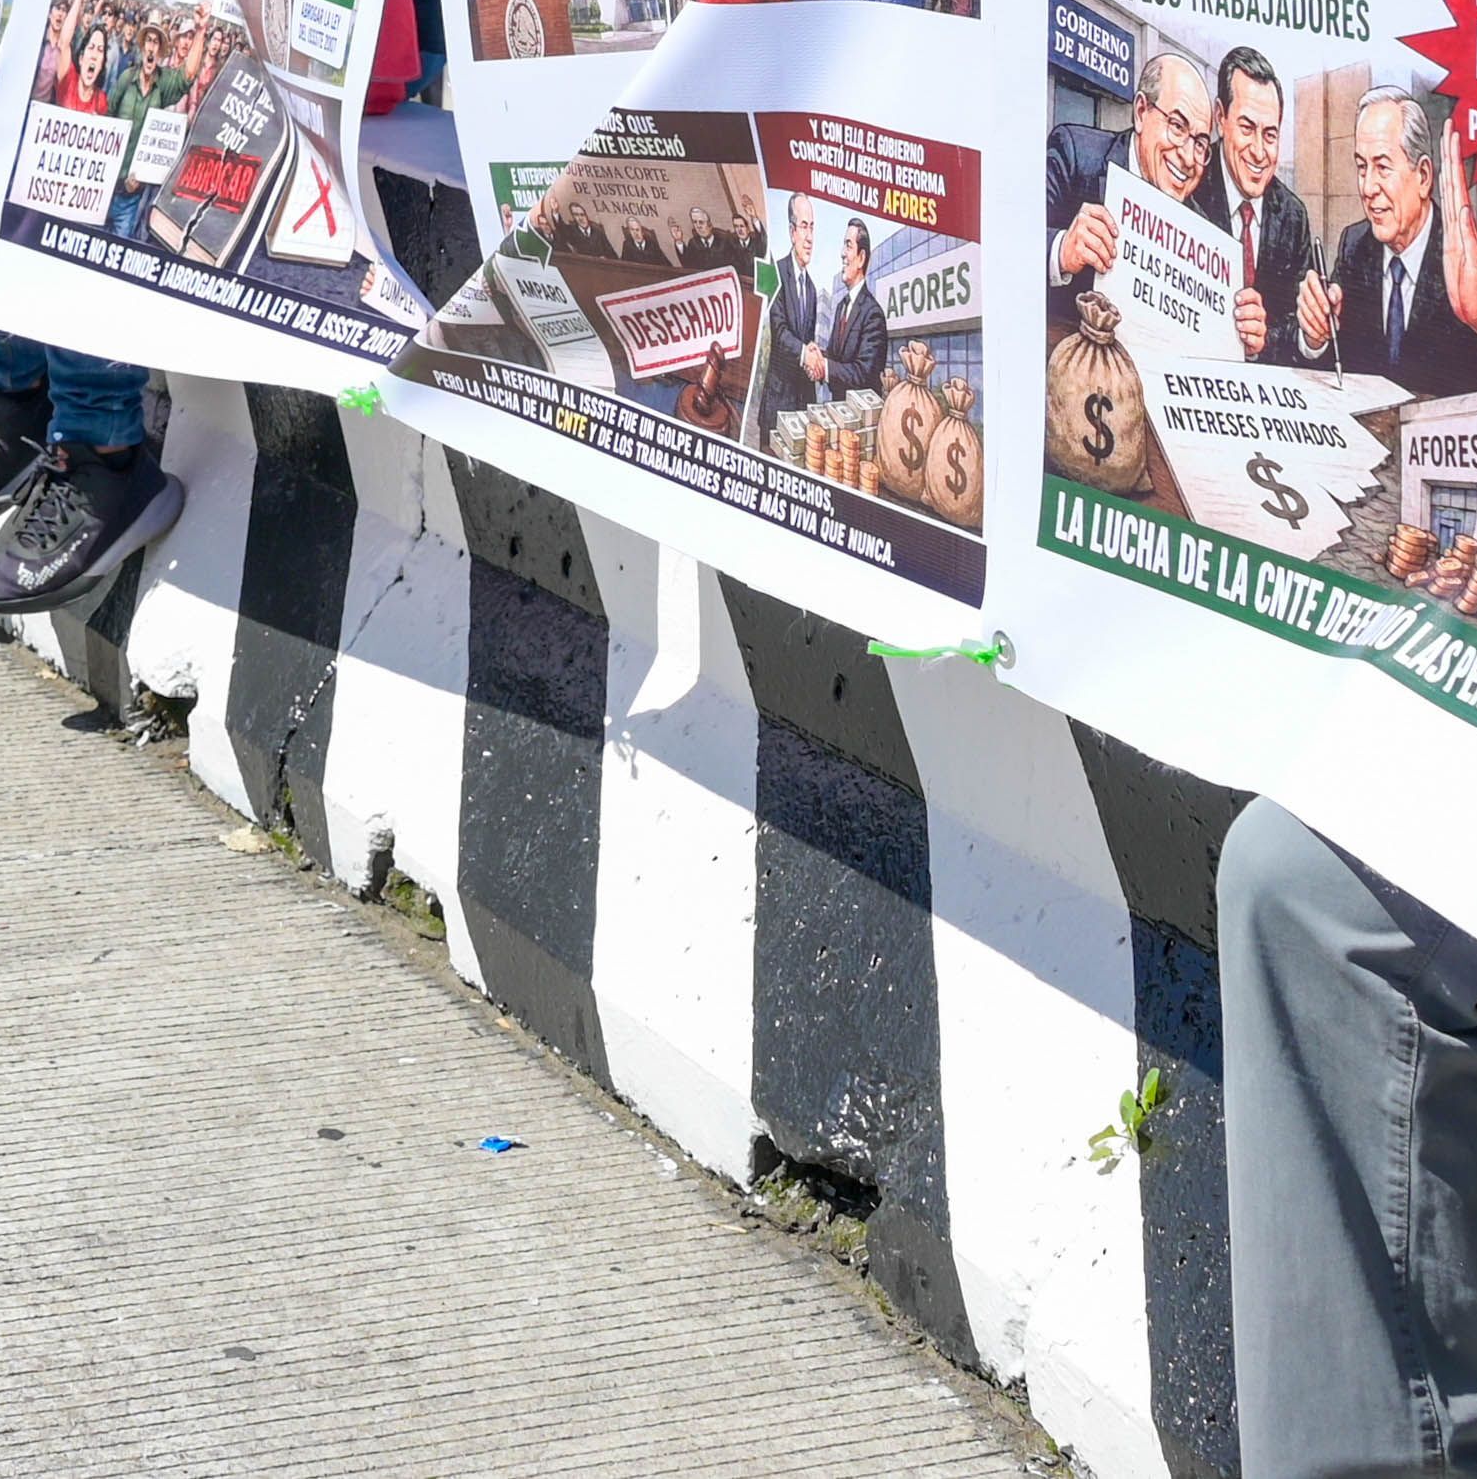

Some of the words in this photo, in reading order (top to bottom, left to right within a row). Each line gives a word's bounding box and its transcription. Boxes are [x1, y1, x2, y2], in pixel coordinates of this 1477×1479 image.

[1055, 6, 1130, 61] GOBIERNO
[1055, 31, 1074, 55] DE
[1077, 36, 1129, 88] MÉXICO
[35, 118, 123, 157] ¡ABROGACIÓN
[28, 176, 68, 206] ISSSTE
[68, 186, 103, 212] 2007!
[37, 150, 46, 170] A
[48, 151, 61, 173] LA
[65, 154, 86, 178] LEY
[87, 160, 106, 183] DEL
[883, 188, 938, 226] AFORES
[1121, 198, 1231, 287] PRIVATIZACIÓN
[41, 222, 57, 248] LA
[57, 227, 89, 258] CNTE
[87, 238, 106, 264] NO
[105, 243, 124, 269] SE
[121, 248, 161, 282] RINDE:
[159, 261, 248, 309] ¡ABROGACIÓN
[238, 288, 255, 312] A
[250, 291, 272, 318] LA
[268, 296, 299, 325] LEY
[292, 302, 321, 333] DEL
[317, 312, 368, 348] ISSSTE
[361, 327, 408, 359] 2007!
[516, 278, 567, 304] AMPARO
[887, 261, 971, 319] AFORES
[619, 291, 734, 349] DESECHADO
[1166, 373, 1256, 410] ENTREGA
[1260, 383, 1272, 405] A
[1276, 385, 1308, 412] LOS
[483, 364, 500, 383] LA
[503, 369, 559, 402] REFORMA
[563, 389, 577, 409] AL
[580, 392, 618, 422] ISSSTE
[619, 408, 637, 434] FUE
[639, 416, 654, 440] UN
[657, 425, 693, 455] GOLPE
[695, 439, 703, 460] A
[707, 442, 765, 482] NUESTROS
[768, 467, 835, 516] DERECHOS,
[1164, 405, 1259, 441] INTERESES
[1264, 414, 1347, 450] PRIVADOS
[1056, 491, 1086, 548] LA
[1090, 504, 1171, 578] LUCHA
[1177, 528, 1209, 585] DE
[1216, 534, 1249, 601] LA
[1254, 563, 1322, 628] CNTE
[1397, 617, 1461, 692] LAS
